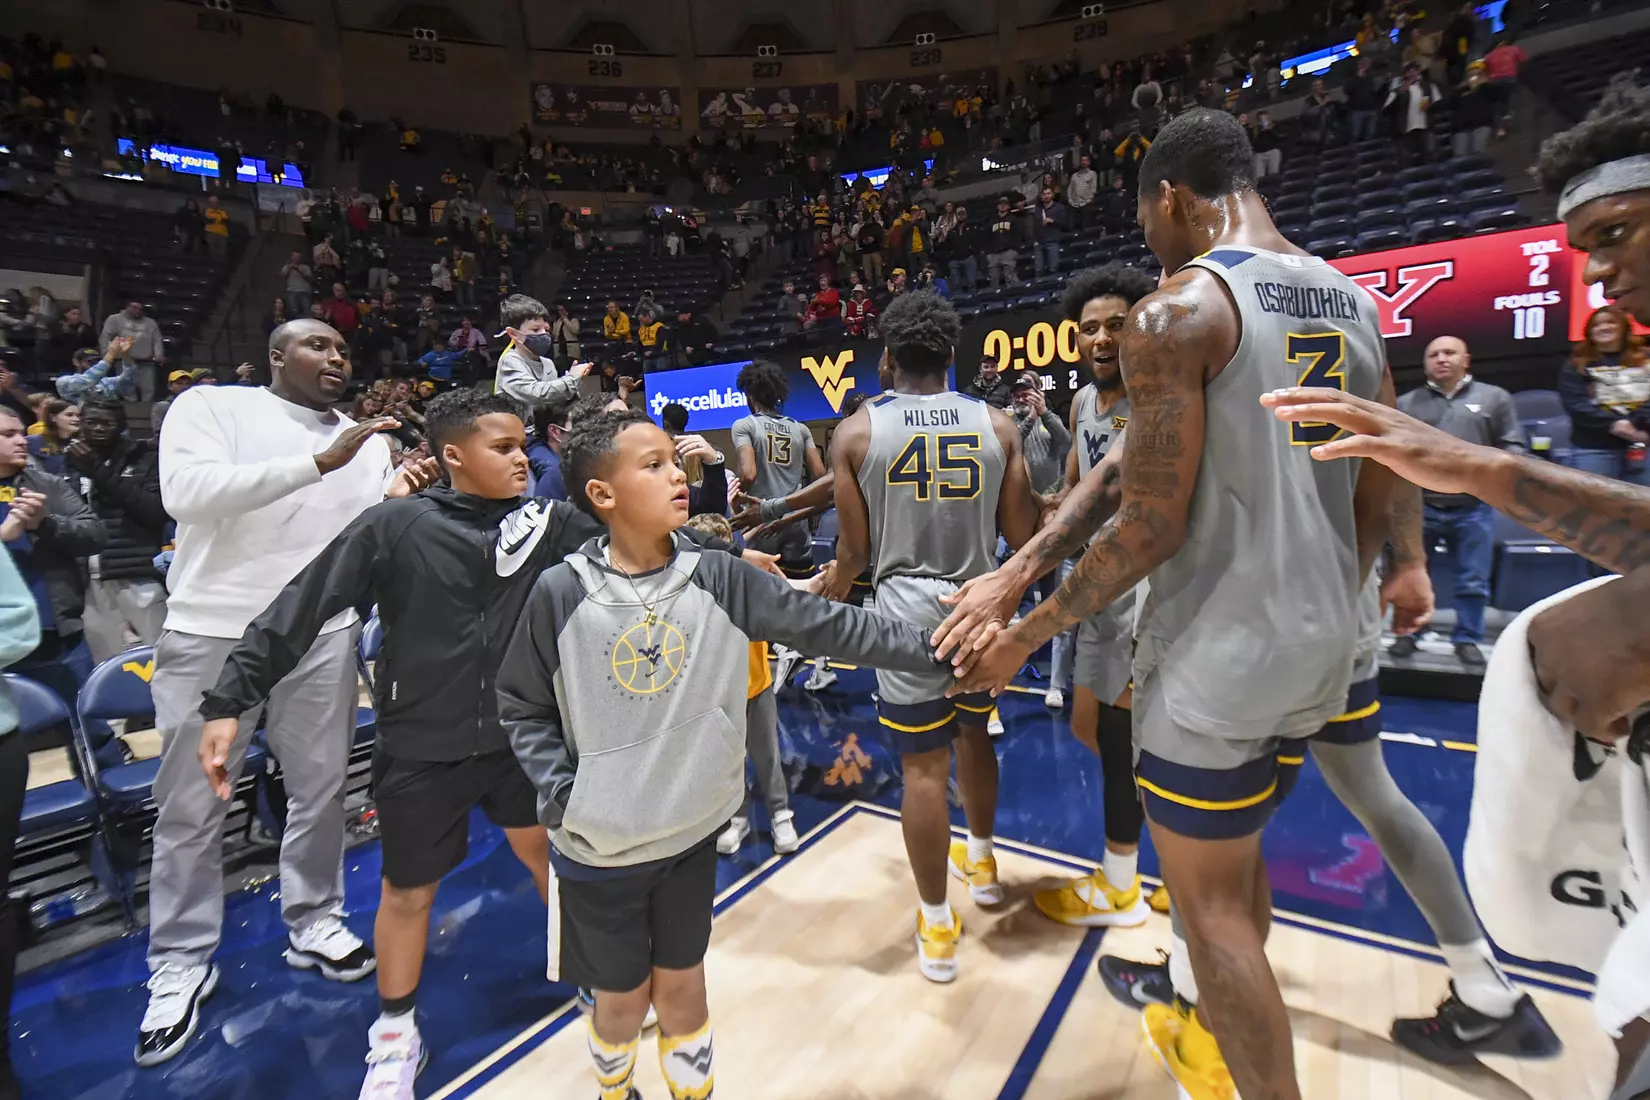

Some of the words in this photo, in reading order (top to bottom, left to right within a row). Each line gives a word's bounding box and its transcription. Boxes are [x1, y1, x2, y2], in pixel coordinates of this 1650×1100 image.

[408, 44, 446, 63] 235
[752, 61, 783, 78] 237
[1520, 239, 1563, 256] TOL
[1528, 254, 1550, 287] 2
[1254, 282, 1361, 322] OSABUOHIEN
[1347, 260, 1454, 339] Y
[1493, 290, 1562, 311] FOULS
[1512, 306, 1546, 340] 10
[983, 319, 1081, 373] 0:00
[1068, 369, 1078, 389] 2
[1286, 331, 1346, 446] 3
[904, 408, 960, 427] WILSON
[765, 431, 792, 467] 13
[886, 432, 982, 501] 45
[498, 499, 542, 551] NIKE
